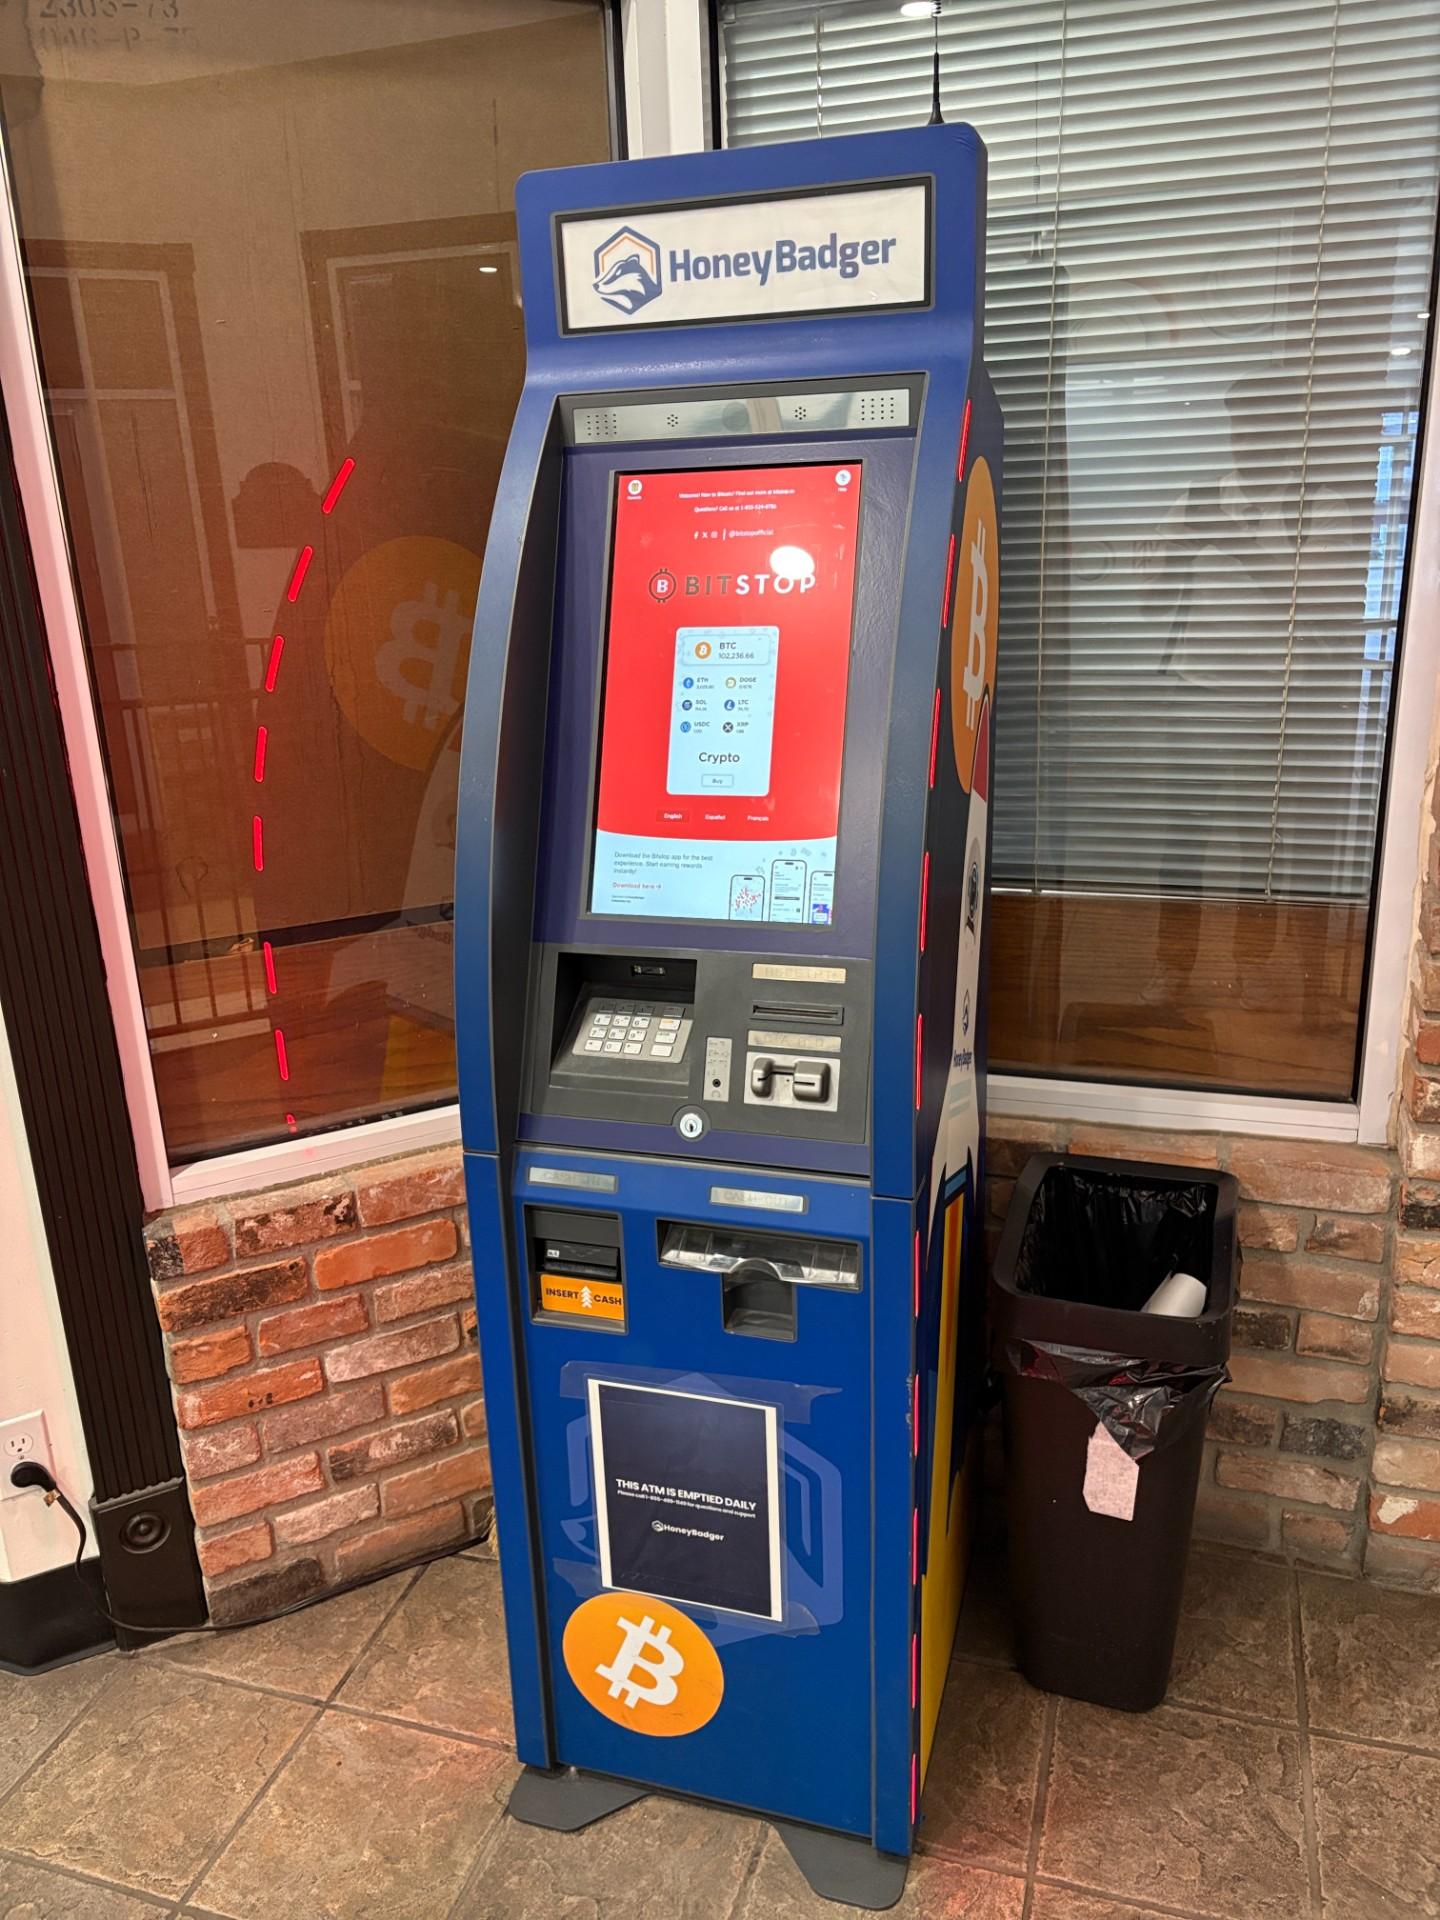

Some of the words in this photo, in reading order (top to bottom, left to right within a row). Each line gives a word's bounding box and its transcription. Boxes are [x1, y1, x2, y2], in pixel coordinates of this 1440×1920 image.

[669, 232, 897, 286] HoneyBadger
[685, 573, 816, 596] BITSTOP
[719, 642, 737, 650] BTC
[698, 751, 740, 764] Crypto
[711, 777, 723, 785] Buy
[663, 812, 682, 821] English
[704, 813, 726, 821] Español
[747, 814, 769, 822] Français
[614, 851, 641, 859] Download
[545, 1287, 579, 1299] INSERT
[593, 1294, 622, 1306] CASH
[615, 1478, 640, 1491] THIS
[641, 1483, 665, 1495] ATM
[666, 1487, 676, 1497] IS
[677, 1489, 724, 1505] EMPTIED
[724, 1497, 757, 1511] DAILY
[617, 1489, 635, 1497] Please
[734, 1510, 756, 1519] support
[663, 1523, 724, 1542] HoneyBadger
